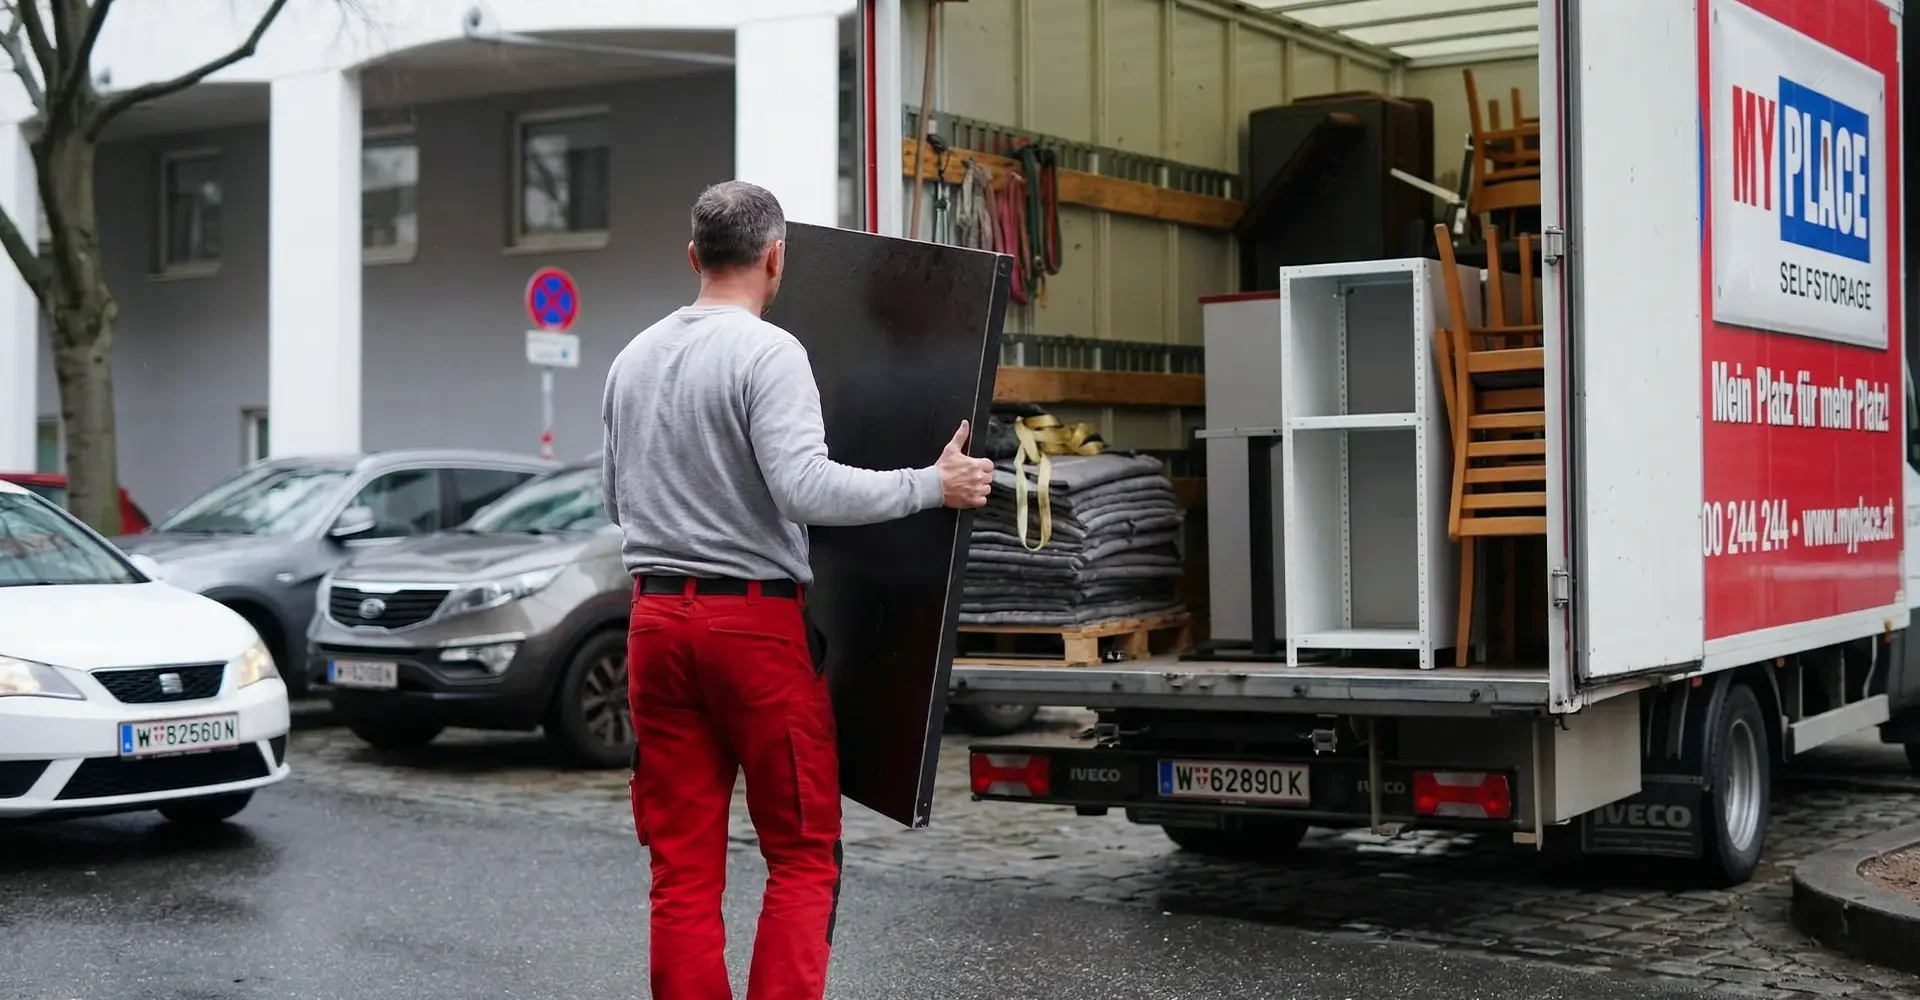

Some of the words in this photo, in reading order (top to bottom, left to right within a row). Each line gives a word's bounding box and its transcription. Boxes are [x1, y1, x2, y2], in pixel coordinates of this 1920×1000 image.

[1732, 84, 1776, 212] MY
[1784, 104, 1868, 240] PLACE
[1779, 261, 1872, 310] SELFSTORAGE
[1711, 360, 1752, 423] Mein
[1756, 365, 1794, 426] Platz
[1796, 370, 1818, 427] für
[1820, 375, 1854, 429] mehr
[1855, 378, 1890, 432] Platz!
[1727, 500, 1758, 554] 244
[1761, 498, 1789, 552] 244
[1802, 495, 1895, 554] www.myplace.at
[1069, 767, 1121, 782] IVECO
[1176, 765, 1193, 791] W
[1356, 779, 1406, 794] IVCO
[1594, 803, 1692, 828] IVECO
